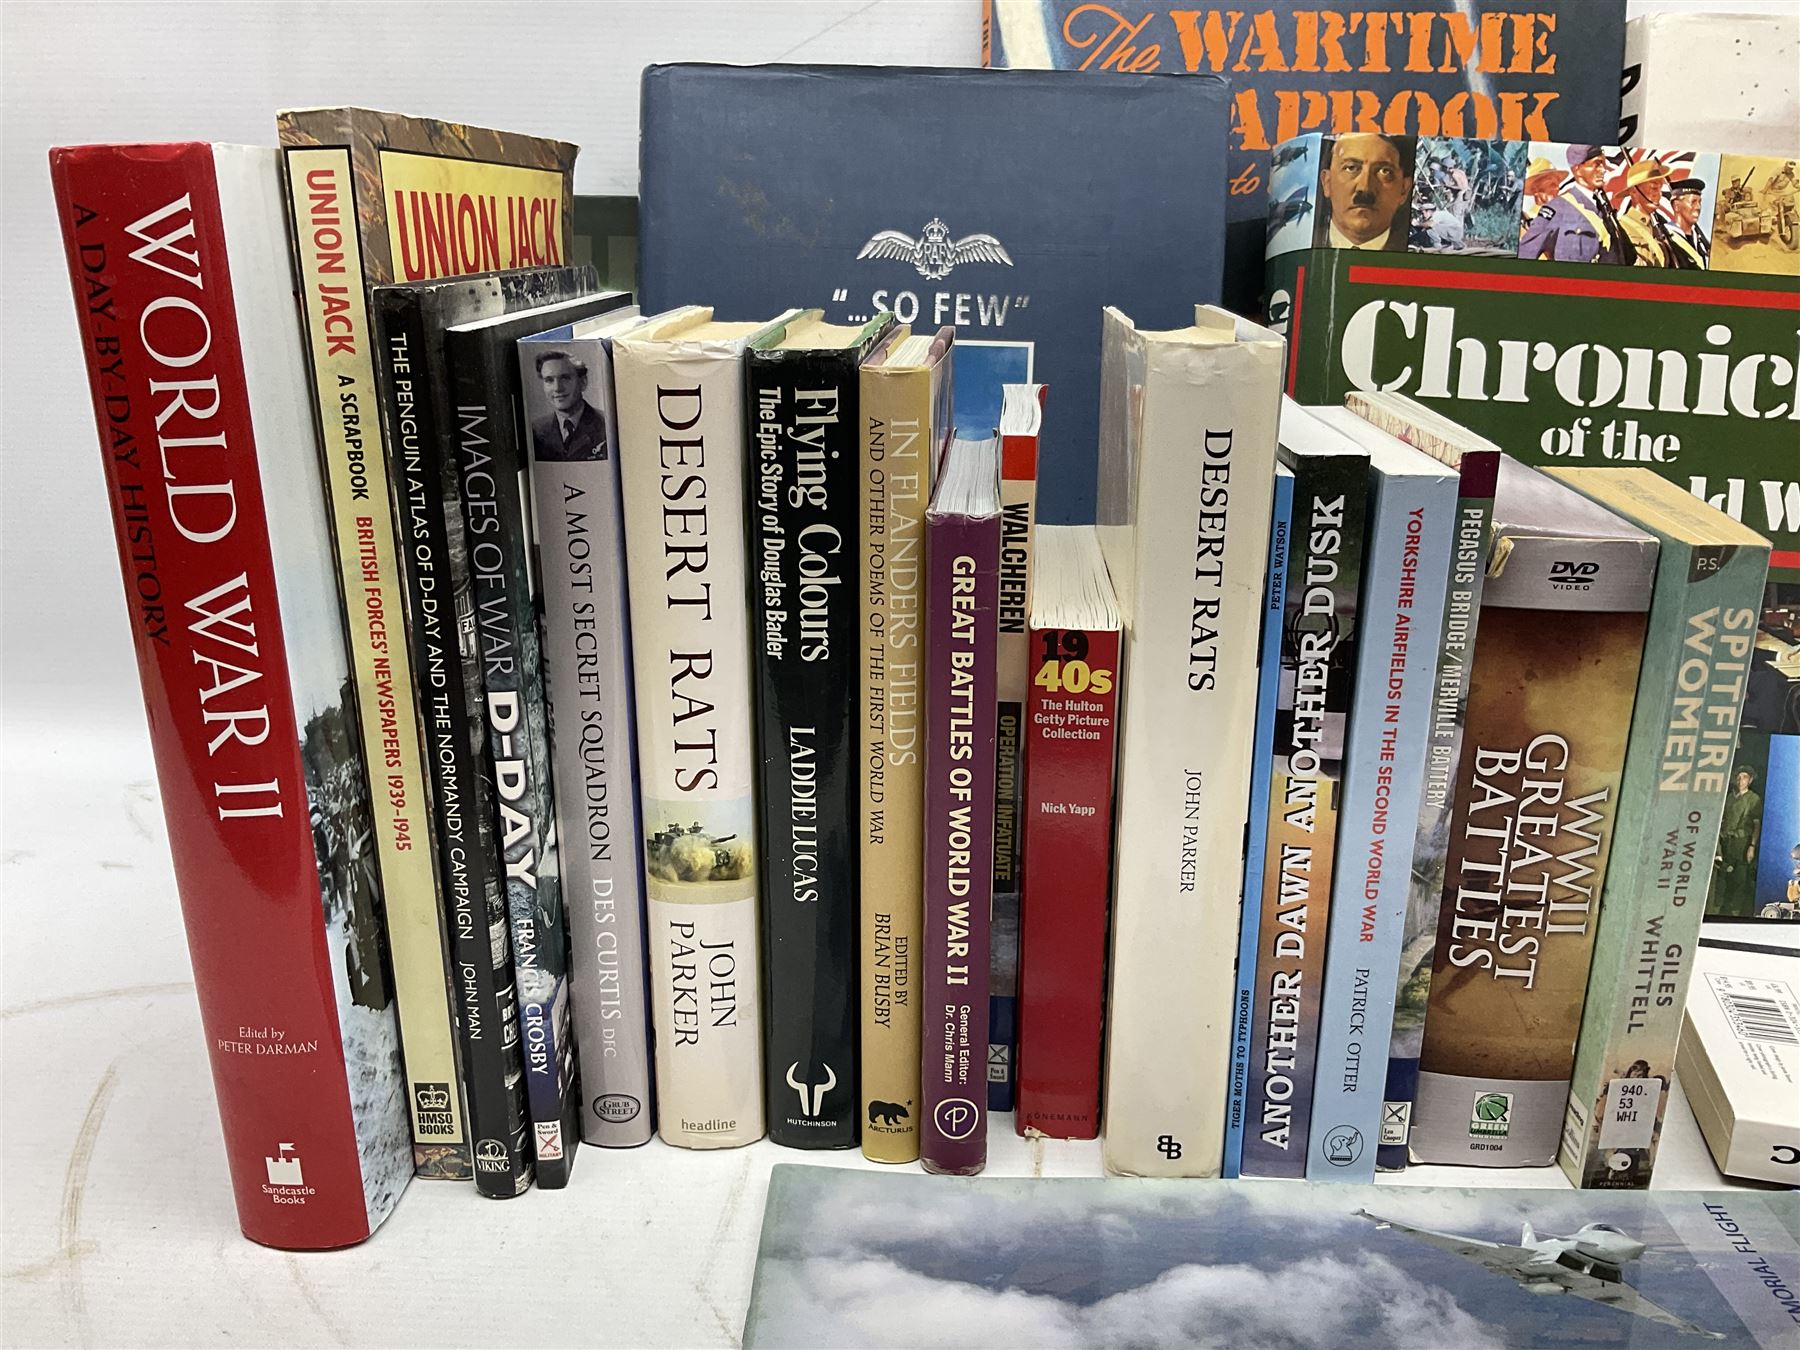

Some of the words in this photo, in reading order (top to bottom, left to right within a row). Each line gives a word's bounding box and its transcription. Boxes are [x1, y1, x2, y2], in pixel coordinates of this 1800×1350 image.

[1063, 3, 1162, 71] The
[1169, 10, 1557, 74] WARTIME
[1229, 88, 1560, 151] APBOOK
[306, 169, 347, 273] UNION
[395, 190, 501, 282] UNION
[507, 196, 560, 269] JACK
[318, 283, 358, 358] JACK
[124, 191, 237, 544] WORLD
[391, 333, 409, 374] THE
[1342, 300, 1800, 421] Chronic
[73, 203, 97, 229] A
[121, 483, 170, 648] HISTORY
[396, 380, 422, 472] PENGUIN
[759, 386, 782, 420] The
[340, 393, 370, 501] SCRAPBOOK
[756, 422, 783, 460] Epic
[786, 386, 840, 511] Flying
[869, 416, 885, 462] AND
[890, 418, 920, 459] IN
[1541, 420, 1592, 458] of
[1602, 417, 1681, 462] the
[457, 405, 499, 533] IMAGES
[563, 483, 584, 504] A
[758, 463, 784, 512] Story
[407, 478, 431, 540] ATLAS
[656, 383, 713, 622] DESERT
[762, 514, 785, 535] of
[869, 469, 885, 536] OTHER
[1195, 428, 1233, 588] DESERT
[355, 517, 380, 583] BRITISH
[415, 546, 433, 572] OF
[473, 543, 506, 589] OF
[566, 511, 593, 593] MOST
[761, 538, 787, 607] Douglas
[890, 472, 919, 650] FLANDERS
[1001, 502, 1029, 633] WALCHEREN
[1275, 520, 1287, 569] WATSON
[1303, 495, 1347, 617] DUSK
[1401, 507, 1424, 609] YORKSHIRE
[1454, 508, 1484, 584] PEGASUS
[1697, 558, 1720, 570] P.S.
[797, 523, 842, 662] Colours
[869, 544, 885, 606] POEMS
[952, 556, 976, 644] GREAT
[1270, 570, 1283, 610] PETER
[1552, 583, 1590, 591] VIDEO
[364, 587, 390, 654] FORCES'
[420, 577, 443, 639] D-DAY
[480, 596, 514, 676] WAR
[766, 610, 788, 661] Bader
[869, 613, 884, 638] OF
[184, 571, 271, 757] WAR
[427, 637, 447, 688] AND
[573, 602, 601, 702] SECRET
[869, 644, 884, 680] THE
[1041, 630, 1089, 662] 19
[1187, 597, 1222, 692] RATS
[1387, 614, 1411, 699] AIRFIELDS
[949, 649, 975, 760] BATTLES
[1034, 660, 1112, 694] 40s
[1659, 607, 1720, 792] WOMEN
[1699, 608, 1754, 793] SPITFIRE
[372, 656, 402, 768] NEWSPAPERS
[431, 694, 452, 733] THE
[669, 648, 719, 791] RATS
[869, 687, 884, 734] FIRST
[889, 661, 917, 768] FIELDS
[1034, 713, 1065, 727] Getty
[1067, 714, 1110, 726] Picture
[1041, 699, 1062, 711] The
[1065, 700, 1103, 712] Hulton
[1284, 630, 1332, 833] ANOTHER
[1385, 705, 1400, 721] IN
[998, 715, 1017, 800] OPERATION
[1042, 728, 1100, 740] Collection
[1380, 728, 1397, 761] THE
[215, 777, 283, 821] II
[436, 733, 464, 843] NORMANDY
[488, 690, 537, 891] D-DAY
[576, 708, 612, 862] SQUADRON
[789, 726, 817, 821] LADDIE
[869, 741, 885, 805] WORLD
[949, 767, 973, 799] OF
[1184, 769, 1202, 819] JOHN
[1374, 764, 1394, 834] SECOND
[1426, 746, 1453, 808] BATTERY
[387, 775, 412, 851] 1939-1945
[869, 810, 885, 845] WAR
[1041, 803, 1066, 814] Nick
[1068, 804, 1096, 817] Yapp
[1687, 811, 1701, 834] OF
[792, 824, 819, 902] LUCAS
[947, 804, 972, 896] WORLD
[995, 804, 1015, 880] INFATUATE
[1180, 826, 1199, 893] PARKER
[1448, 745, 1523, 968] BATTLES
[1494, 734, 1569, 989] GREATEST
[1545, 787, 1609, 936] WWII
[1660, 828, 1679, 871] WAR
[450, 848, 473, 939] CAMPAIGN
[1365, 841, 1386, 901] WORLD
[1673, 842, 1696, 907] WORLD
[592, 878, 617, 928] DES
[947, 901, 970, 958] WAR
[1273, 844, 1313, 959] DAWN
[1359, 905, 1377, 942] WAR
[516, 918, 541, 1000] FRANCIS
[874, 912, 891, 968] BRIAN
[895, 936, 908, 987] EDITED
[460, 961, 480, 1002] JOHN
[597, 932, 623, 1017] CURTIS
[669, 920, 699, 1047] PARKER
[700, 938, 737, 1029] JOHN
[874, 973, 891, 1029] BUSBY
[895, 991, 908, 1007] BY
[946, 965, 969, 986] II
[1348, 968, 1370, 1034] PATRICK
[1627, 916, 1664, 1034] WHITTELL
[1656, 944, 1682, 1007] GILES
[239, 1027, 267, 1039] Edited
[271, 1027, 285, 1041] by
[468, 1007, 482, 1039] MAN
[525, 1003, 549, 1075] CROSBY
[945, 1004, 956, 1019] Dr.
[945, 1022, 956, 1051] Chris
[959, 1004, 971, 1046] General
[1239, 989, 1250, 1042] TYPHOONS
[218, 1040, 252, 1054] PETER
[256, 1040, 318, 1055] DARMAN
[602, 1028, 617, 1057] DFC
[944, 1054, 955, 1083] Mann
[959, 1049, 970, 1085] Editor:
[1238, 1044, 1246, 1062] TO
[1261, 969, 1302, 1151] ANOTHER
[1342, 1041, 1361, 1093] OTTER
[602, 1100, 631, 1109] GRUB
[1234, 1063, 1244, 1096] MOTHS
[1619, 1098, 1633, 1109] 53
[1621, 1085, 1648, 1096] 940.
[417, 1114, 454, 1125] HMSO
[418, 1124, 455, 1135] BOOKS
[598, 1107, 637, 1117] STREET
[681, 1117, 737, 1131] headline
[786, 1118, 838, 1128] HUTCHINSON
[868, 1123, 913, 1134] ARCTURUS
[1232, 1098, 1241, 1129] TIGER
[1472, 1122, 1508, 1131] GREEN
[1616, 1111, 1638, 1122] WHI
[477, 1159, 510, 1172] VIKING
[1469, 1143, 1503, 1151] GRD1004
[262, 1185, 315, 1195] Sandcastle
[273, 1195, 305, 1205] Books
[1703, 1202, 1757, 1253] FLIGHT
